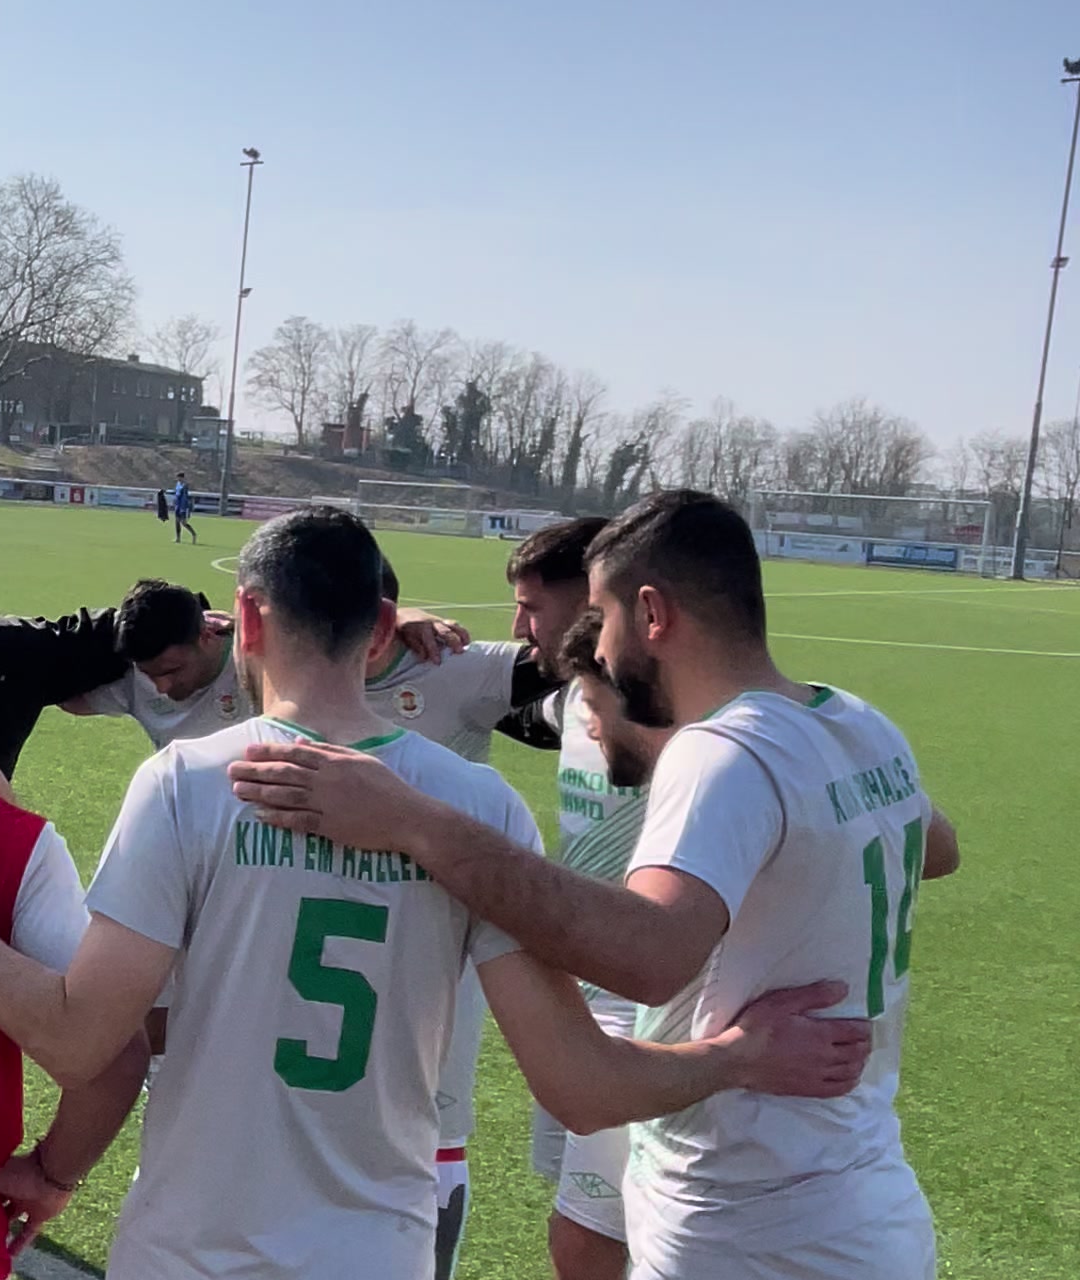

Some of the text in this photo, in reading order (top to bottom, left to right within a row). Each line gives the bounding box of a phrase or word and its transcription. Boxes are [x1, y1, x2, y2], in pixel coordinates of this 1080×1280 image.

[236, 821, 294, 868] KINA
[304, 833, 333, 873] EM
[274, 897, 390, 1092] 5
